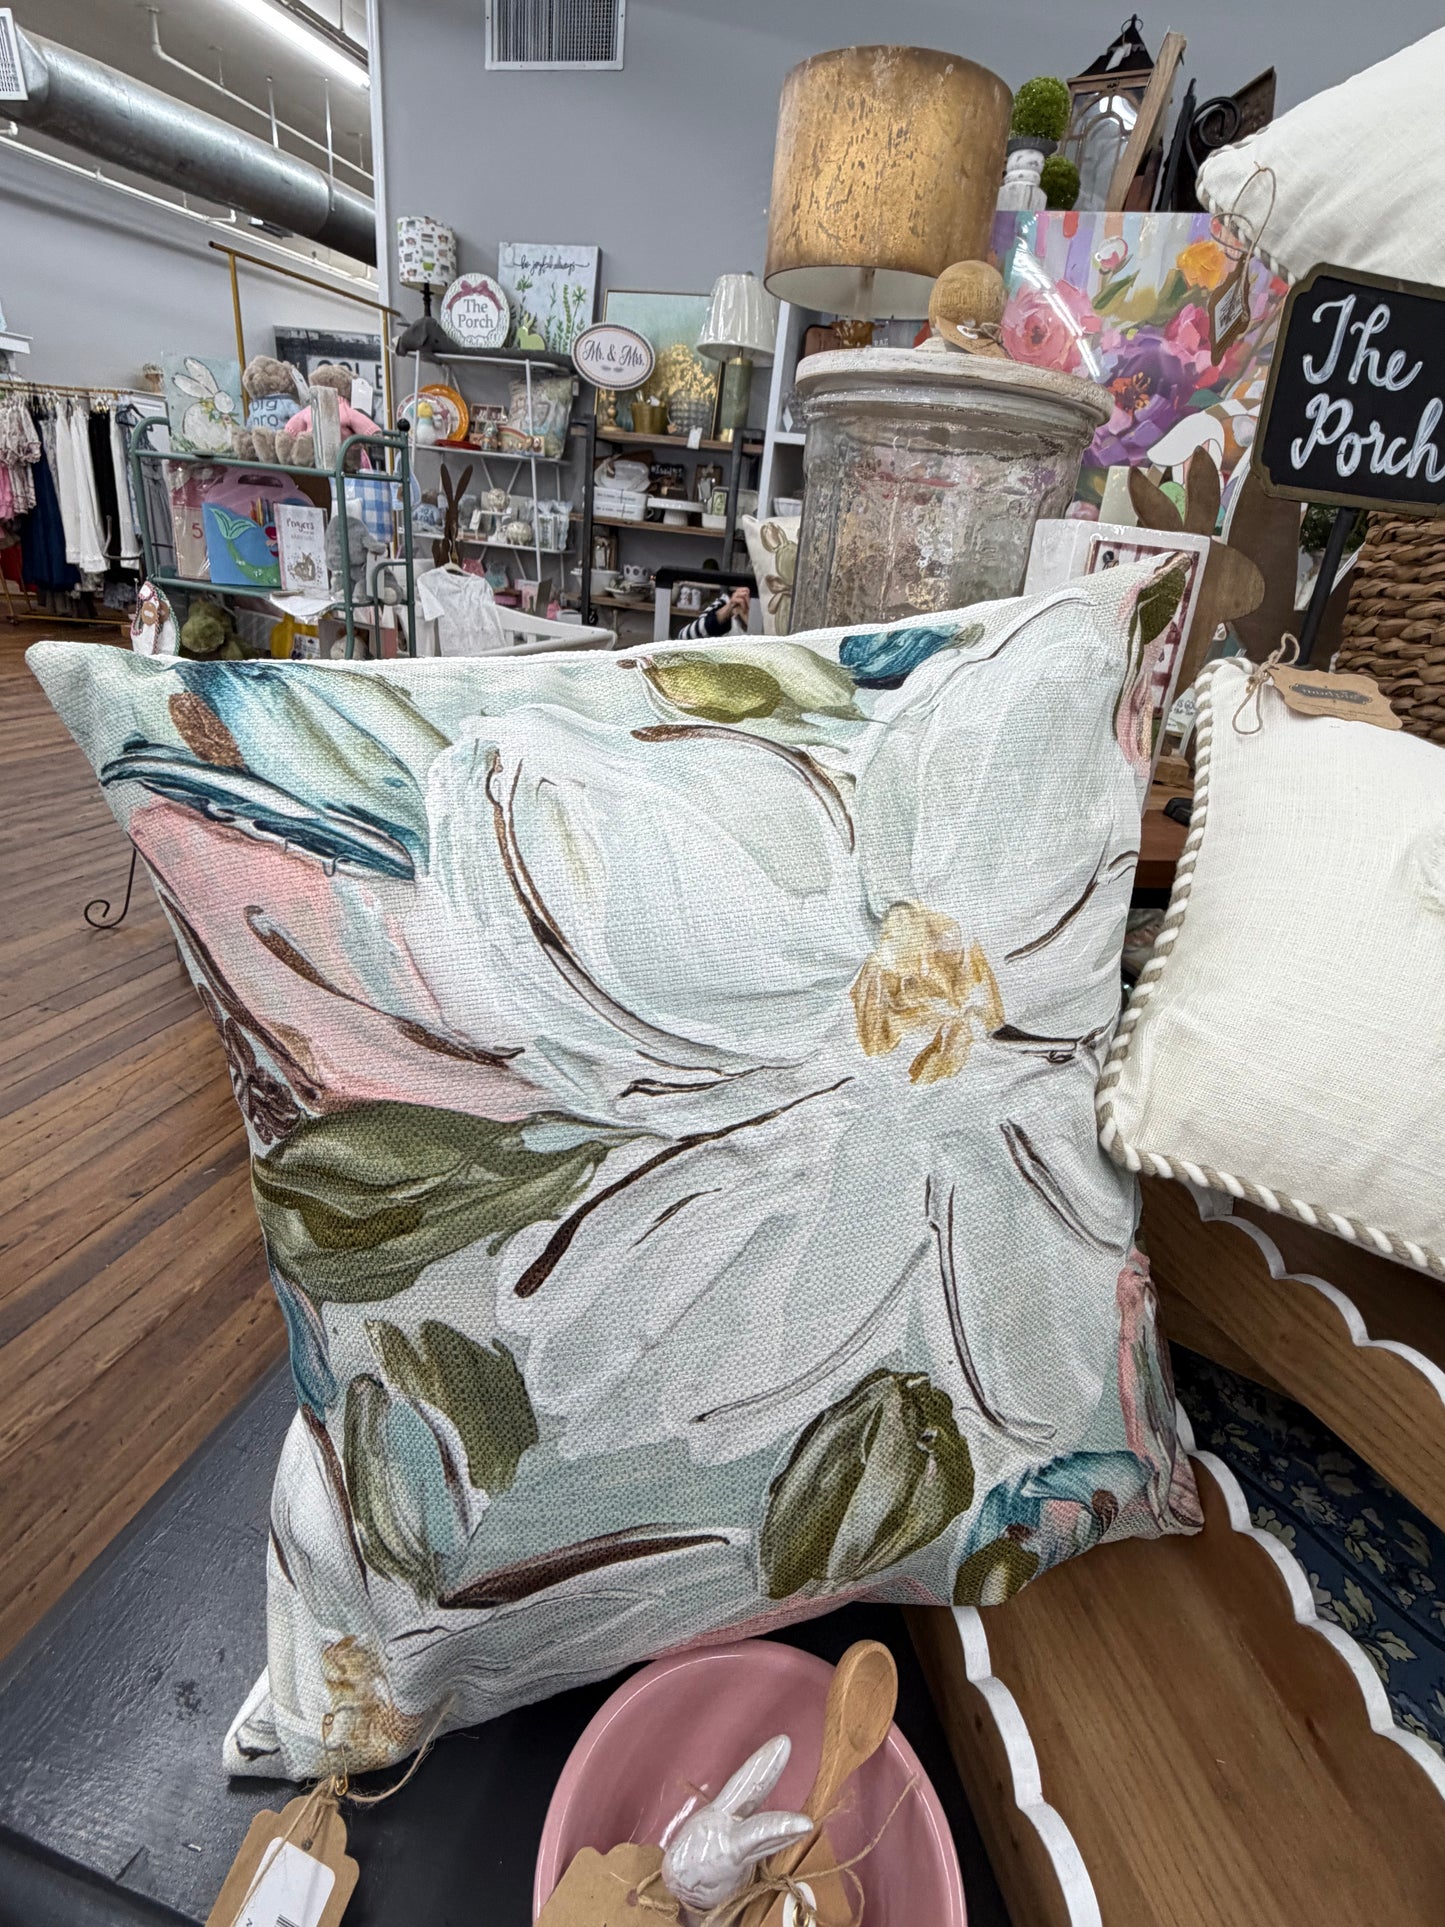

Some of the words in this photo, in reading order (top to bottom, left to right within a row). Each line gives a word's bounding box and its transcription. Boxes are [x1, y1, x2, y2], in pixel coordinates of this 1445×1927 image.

[463, 299, 489, 313] The
[458, 314, 494, 328] Porch
[1302, 293, 1424, 391] The
[582, 340, 605, 362] Mr.
[606, 344, 617, 362] &
[619, 345, 645, 367] Mrs.
[1290, 392, 1445, 484] Porch
[191, 522, 204, 539] 5
[286, 517, 315, 533] Prayers
